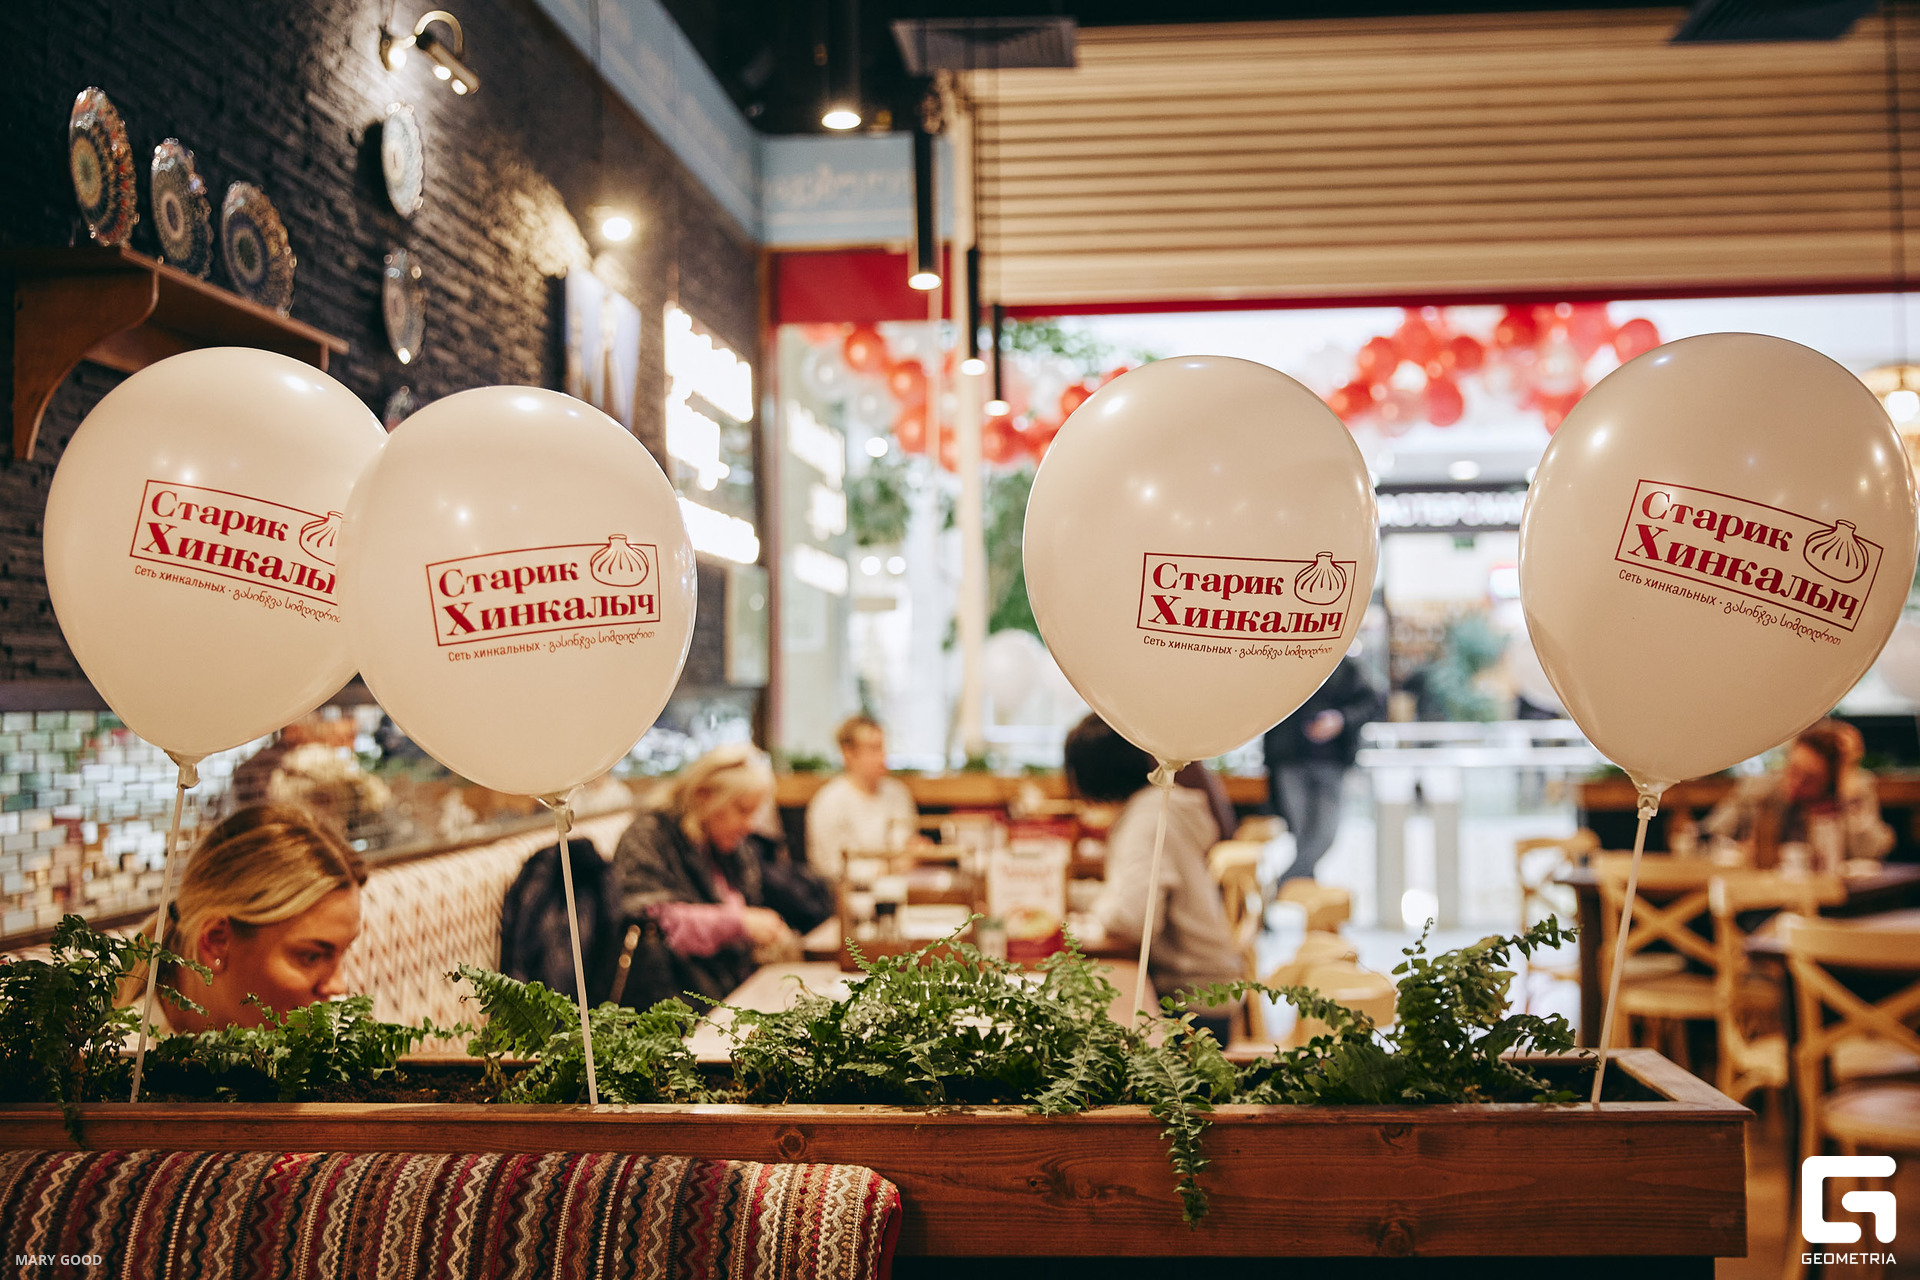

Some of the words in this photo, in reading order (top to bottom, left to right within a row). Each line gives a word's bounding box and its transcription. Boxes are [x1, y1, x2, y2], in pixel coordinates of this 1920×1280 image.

[151, 490, 289, 541] Старик
[1641, 490, 1793, 552] Старик
[141, 522, 336, 595] Хинкалы
[1627, 523, 1860, 621] Хинкалыч
[135, 564, 157, 578] Сеть
[158, 572, 226, 594] хинкальных
[439, 562, 580, 598] Старик
[1153, 562, 1285, 601] Старик
[1618, 568, 1642, 585] Сеть
[1644, 577, 1717, 606] хинкальных
[443, 594, 654, 636] Хинкалыч
[1148, 594, 1343, 633] Хинкалыч
[448, 650, 471, 662] Сеть
[474, 641, 540, 658] хинкальных
[1143, 635, 1166, 647] Сеть
[1168, 640, 1232, 655] хинкальных
